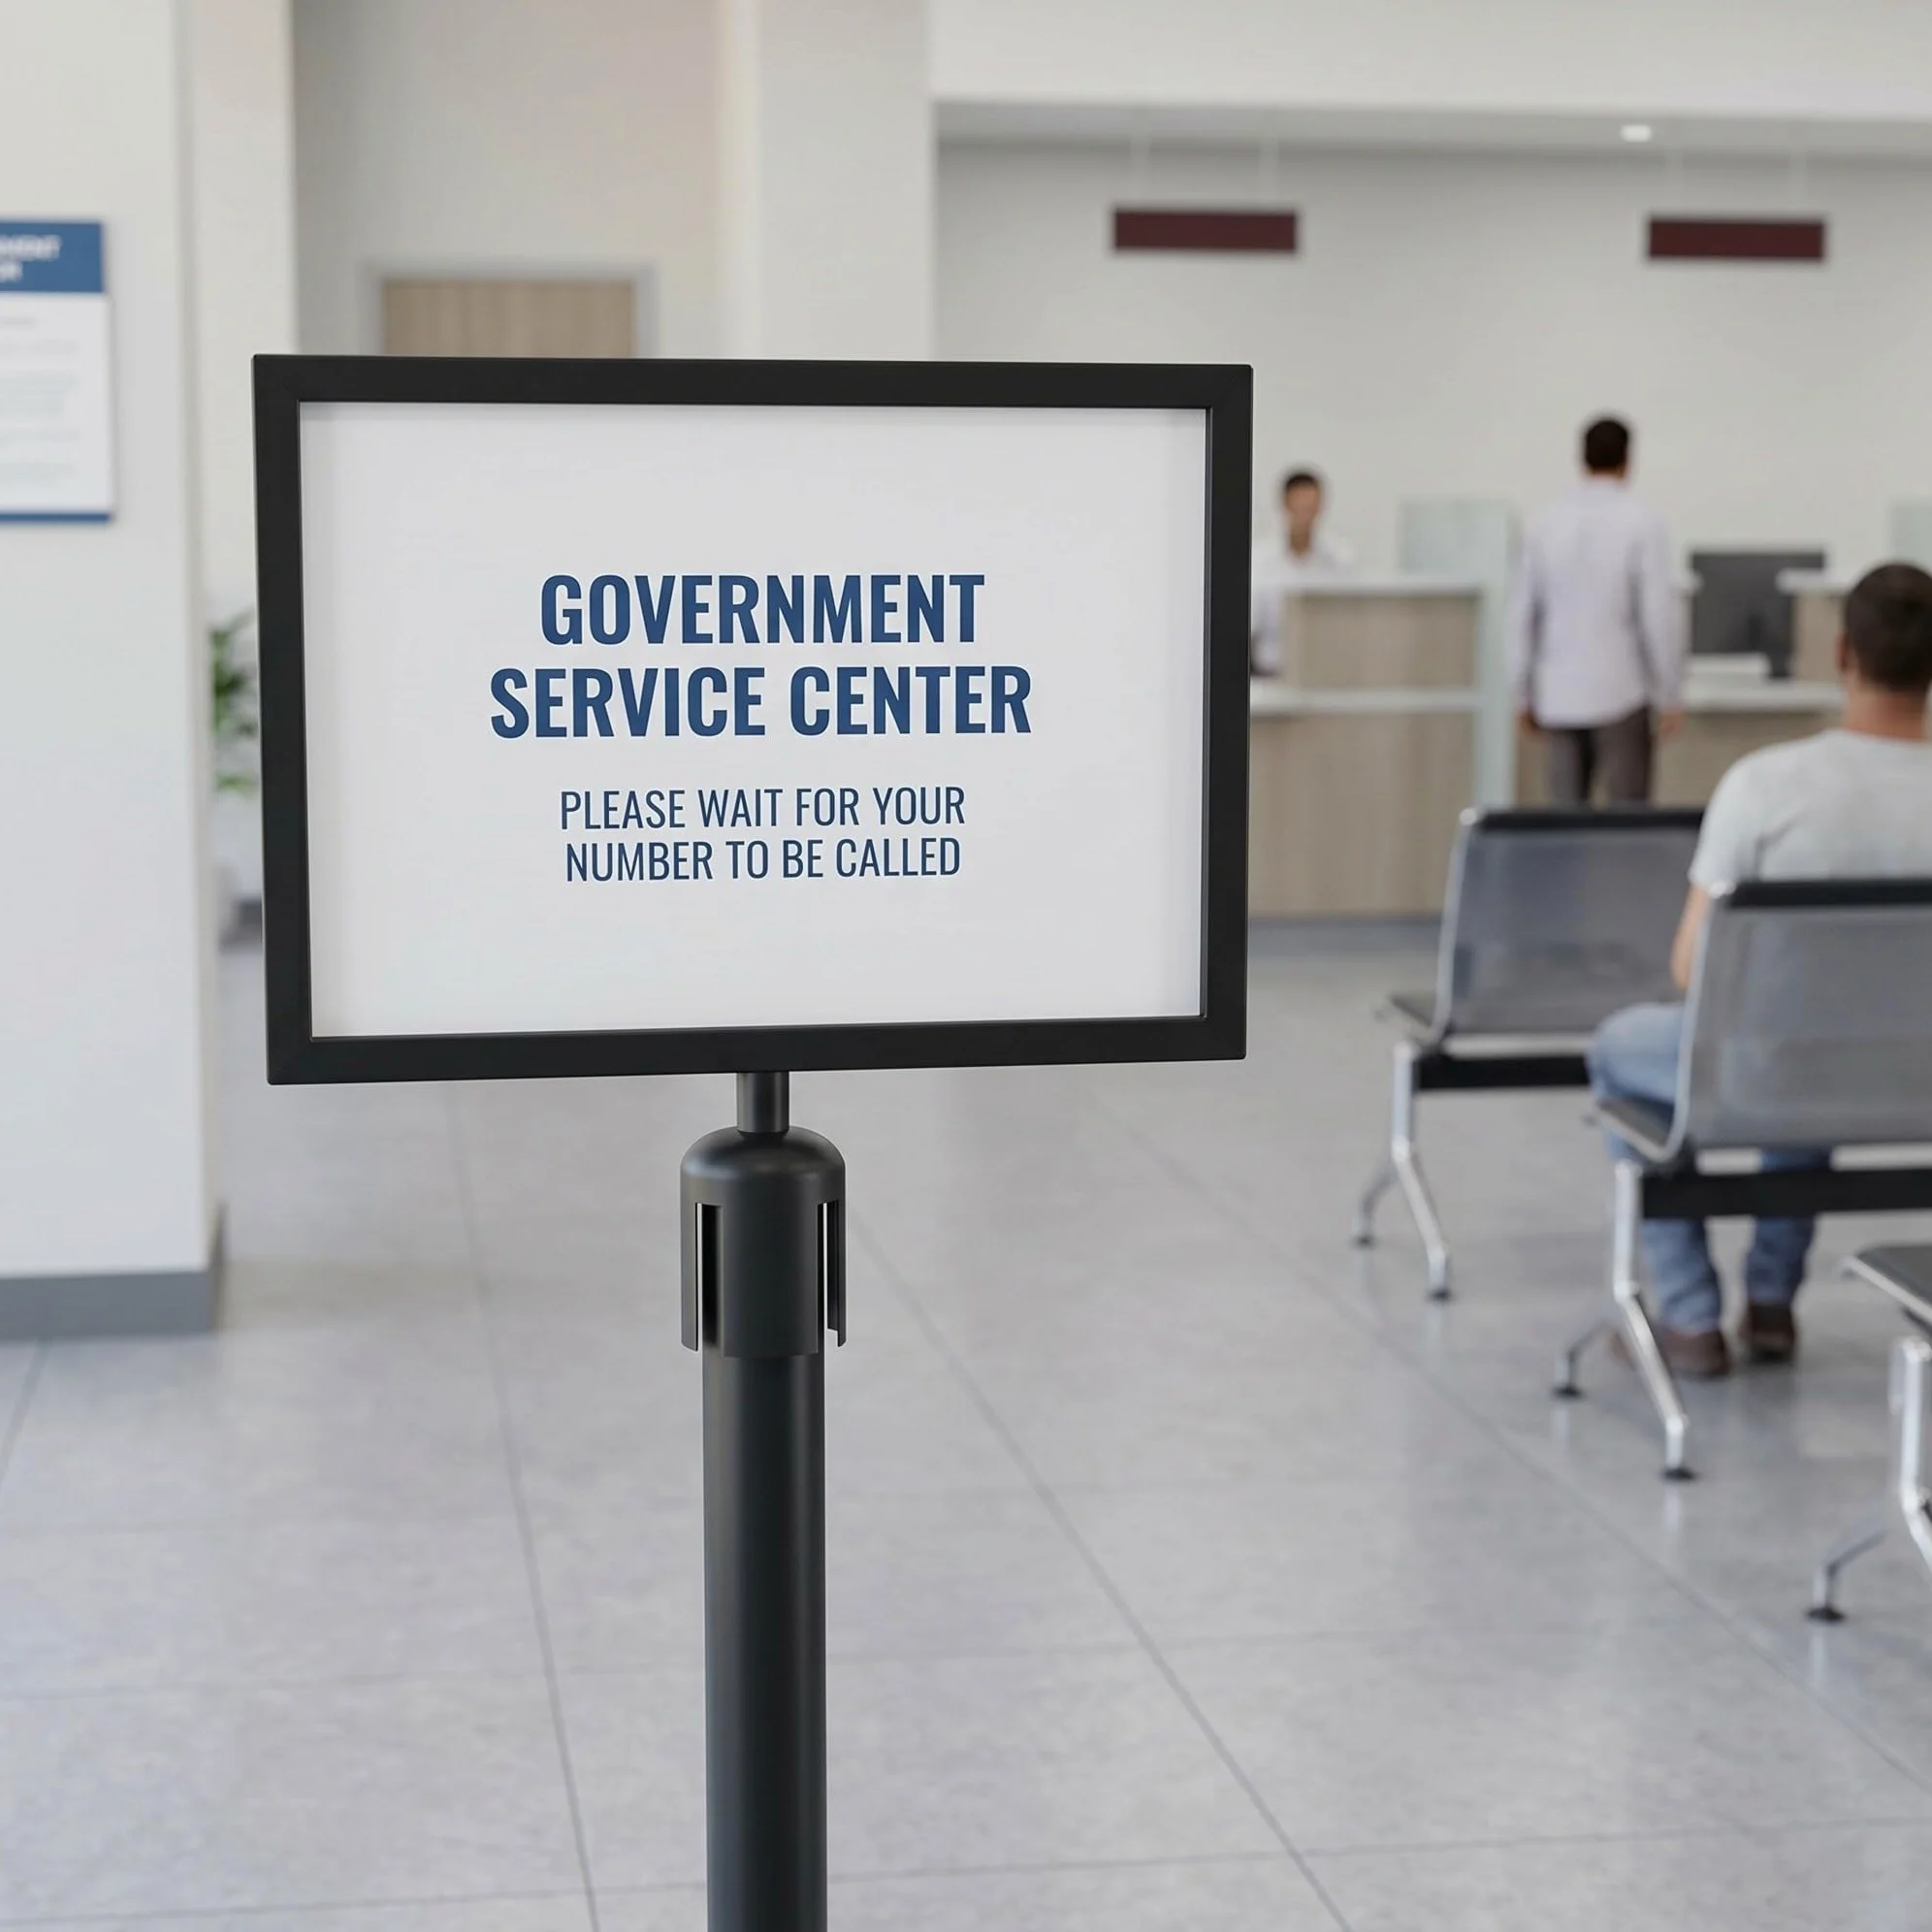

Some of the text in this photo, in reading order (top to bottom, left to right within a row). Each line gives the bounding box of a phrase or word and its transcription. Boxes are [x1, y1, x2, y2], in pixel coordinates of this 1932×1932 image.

[540, 574, 985, 645] GOVERNMENT
[490, 666, 1032, 738] SERVICE CENTER
[561, 787, 965, 829] PLEASE WAIT FOR YOUR
[566, 838, 960, 882] NUMBER TO BE CALLED
